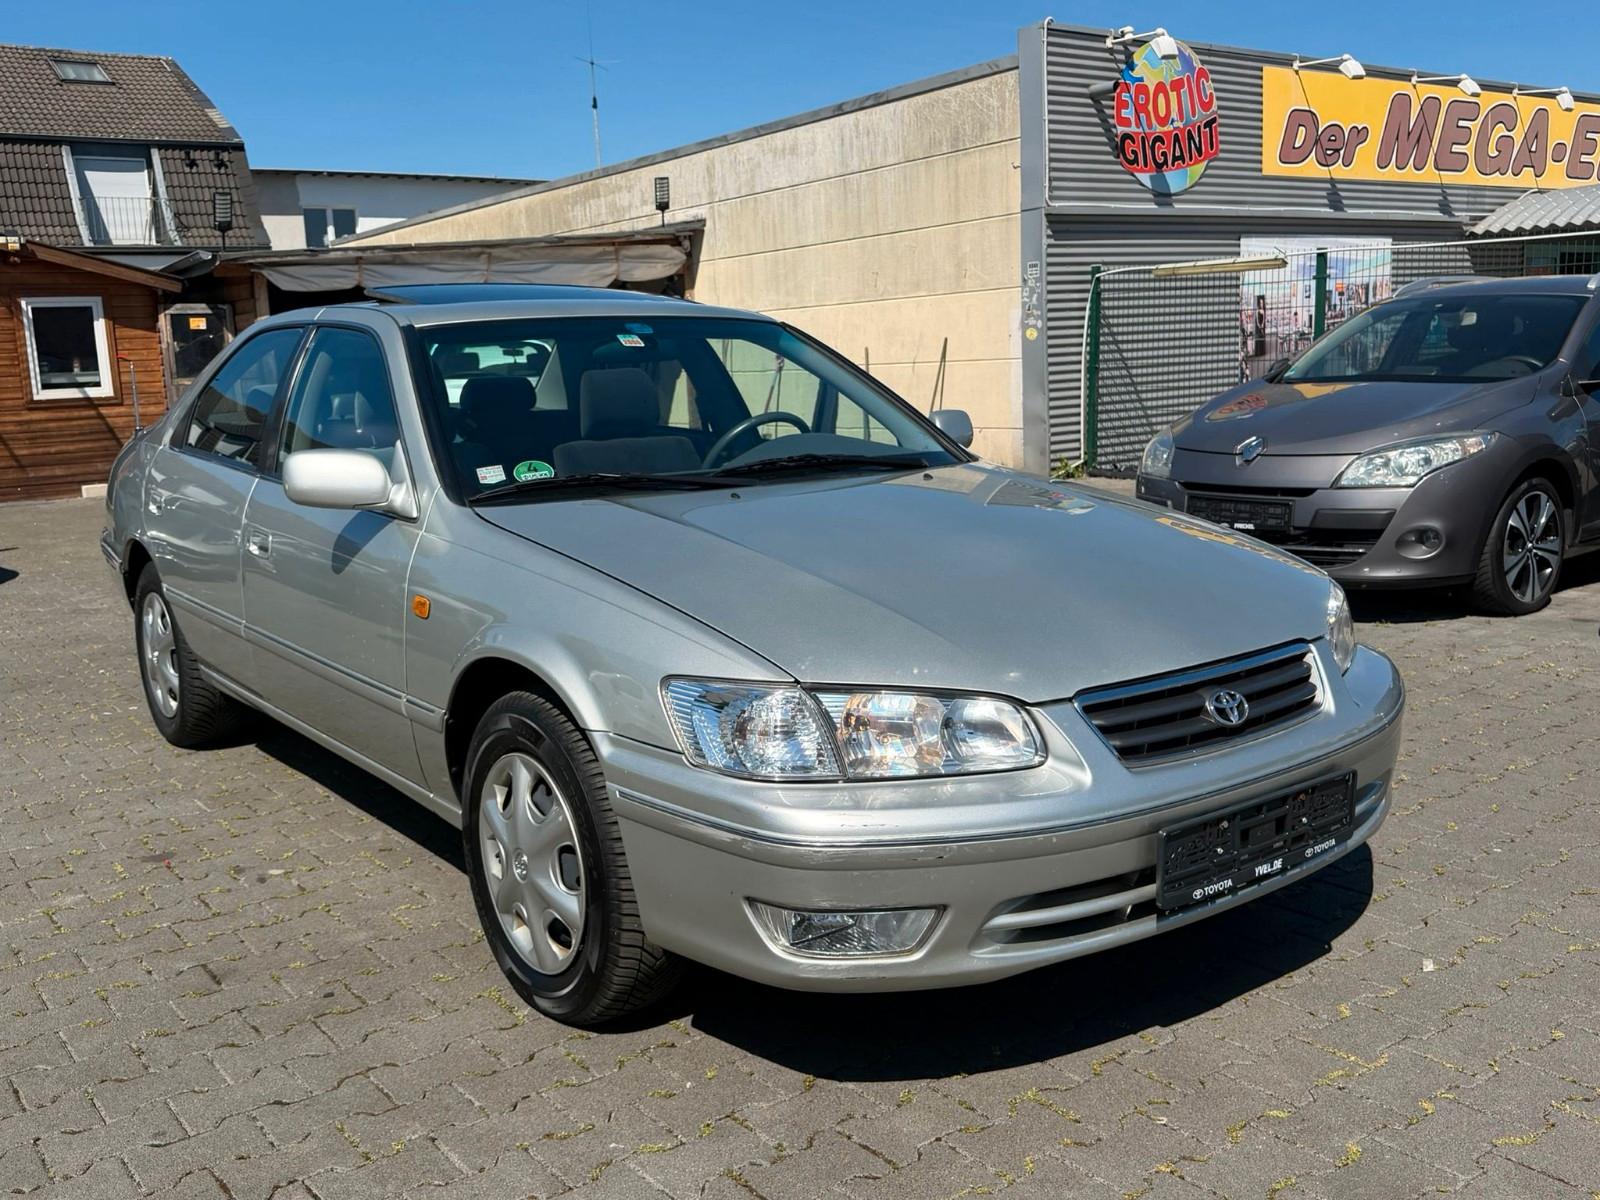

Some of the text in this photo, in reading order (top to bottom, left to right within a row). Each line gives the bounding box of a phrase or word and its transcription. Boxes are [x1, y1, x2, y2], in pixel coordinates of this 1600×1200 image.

[1114, 66, 1216, 130] EROTIC
[1119, 115, 1218, 170] GIGANT
[1278, 108, 1369, 168] Der
[1313, 839, 1336, 854] TOYOTA
[1204, 879, 1233, 896] TOYOTA
